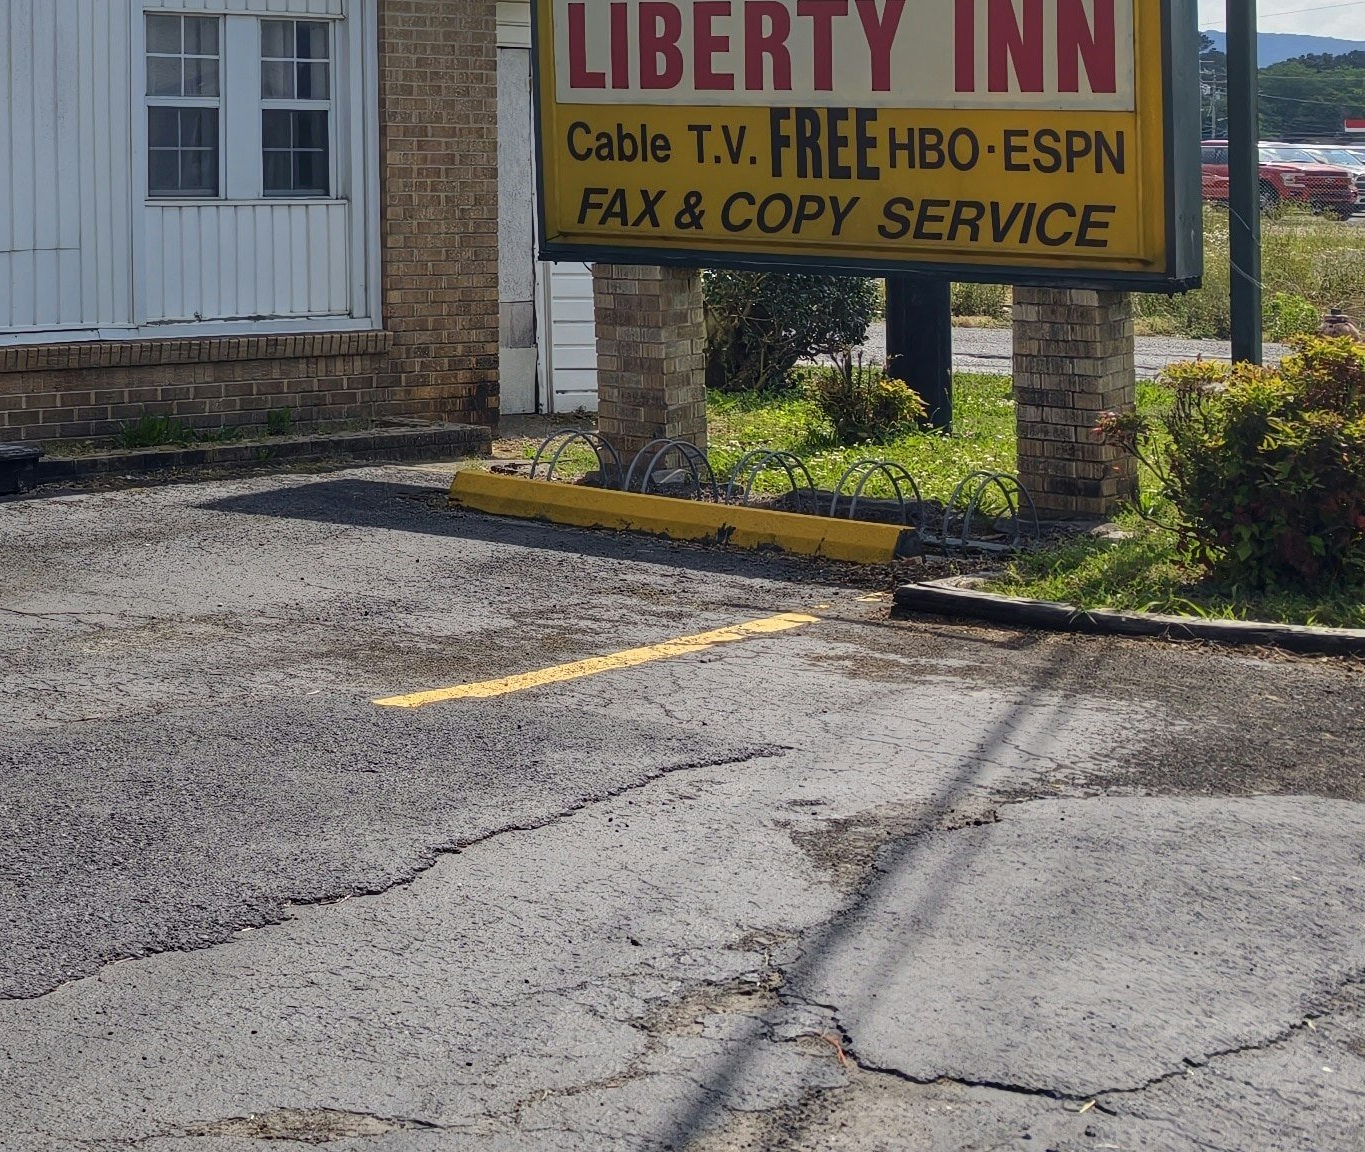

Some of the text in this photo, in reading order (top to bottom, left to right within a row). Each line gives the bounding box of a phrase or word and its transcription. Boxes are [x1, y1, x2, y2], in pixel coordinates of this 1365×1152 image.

[568, 121, 671, 164] Cable
[687, 124, 757, 165] T.V.
[770, 107, 881, 181] FREE
[577, 188, 1117, 249] FAX & COPY SERVICE
